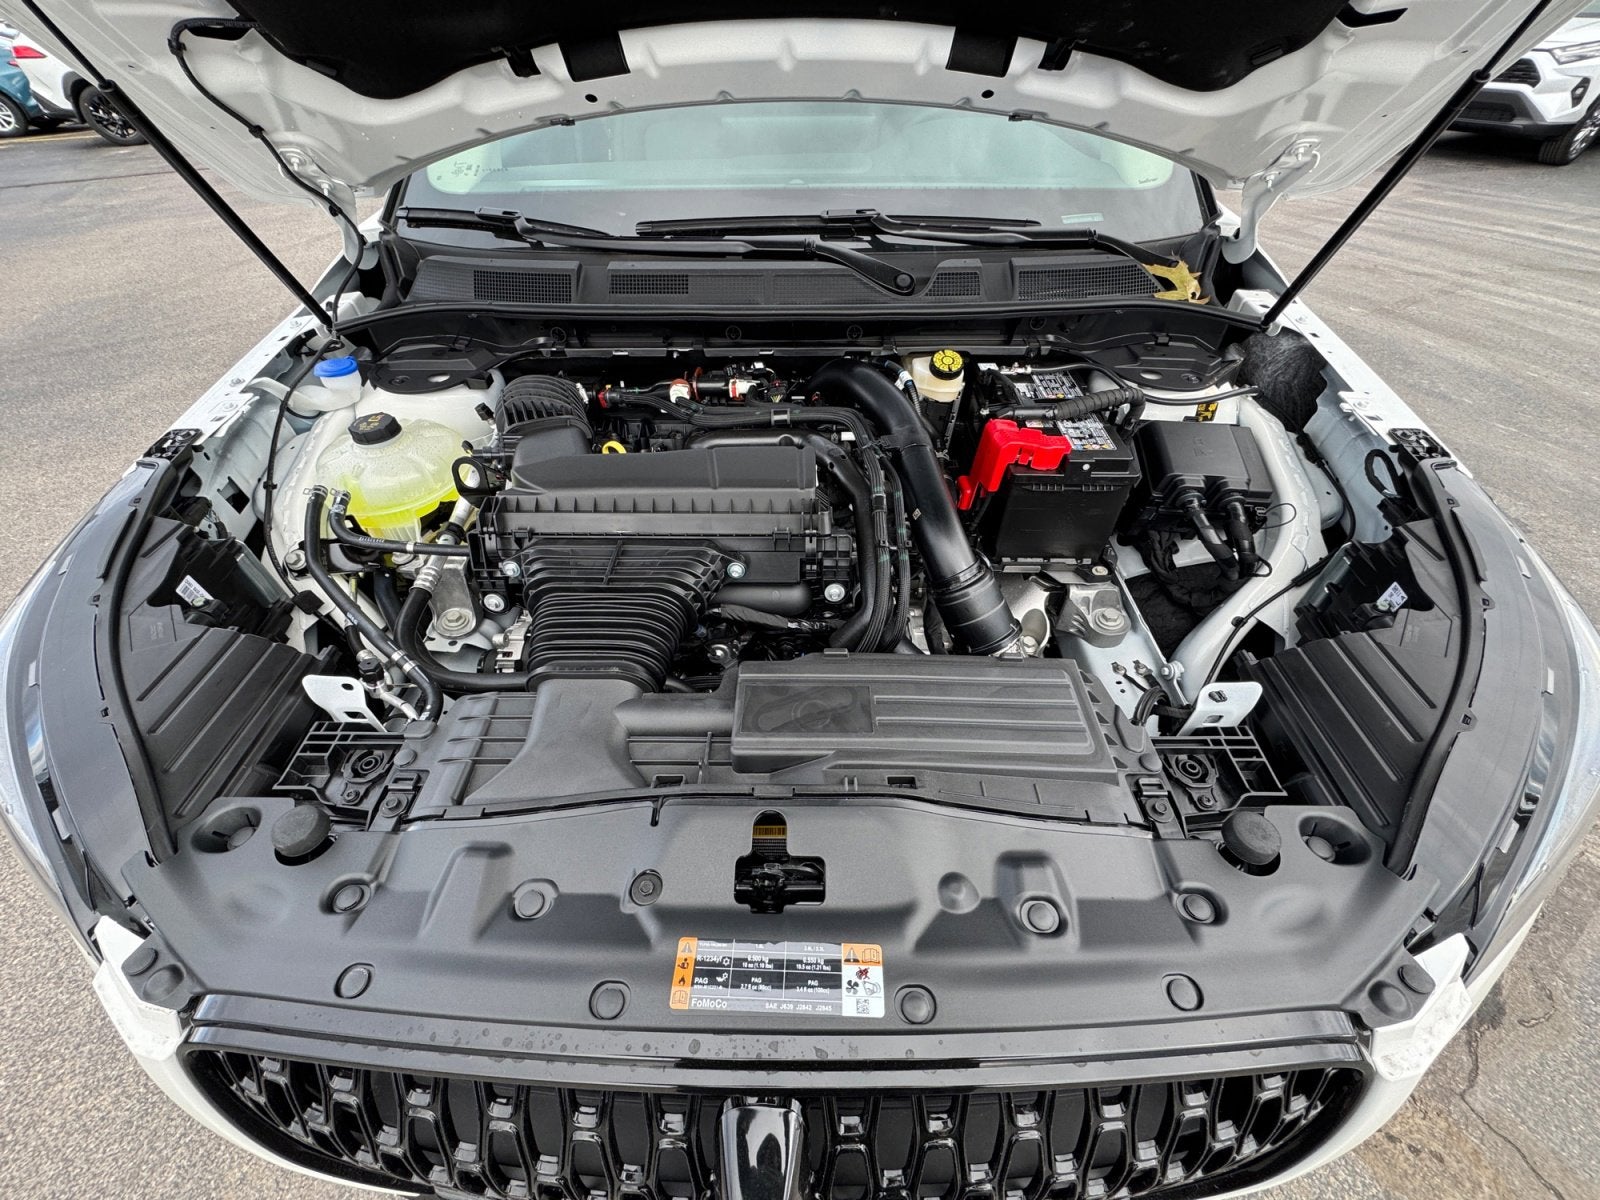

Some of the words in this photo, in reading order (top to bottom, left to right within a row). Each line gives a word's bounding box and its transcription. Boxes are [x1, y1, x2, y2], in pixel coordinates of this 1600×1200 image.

[694, 977, 708, 985] PAG
[751, 976, 762, 984] PAG
[691, 998, 728, 1009] FoMoCo
